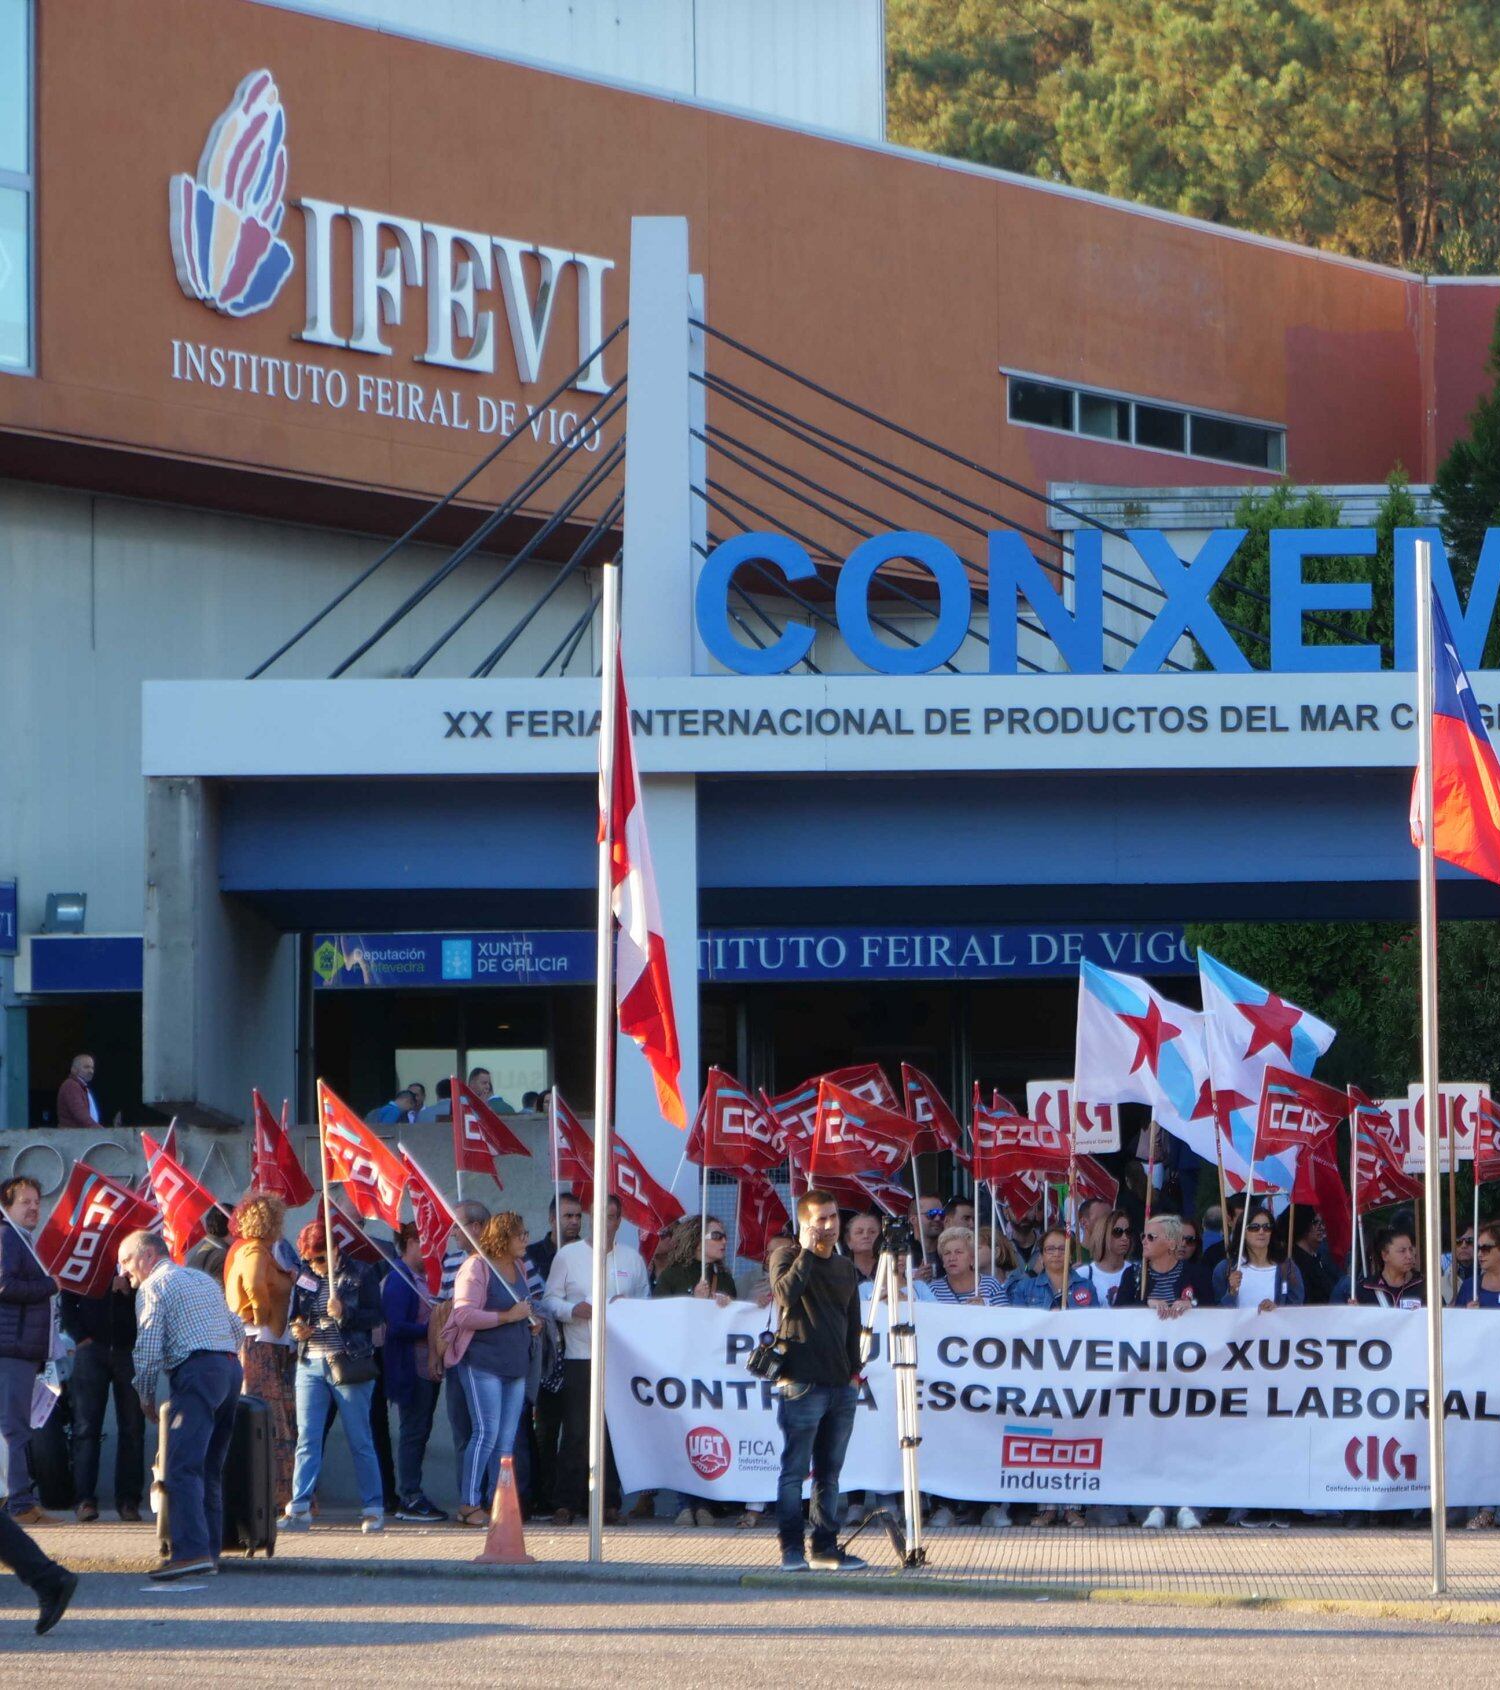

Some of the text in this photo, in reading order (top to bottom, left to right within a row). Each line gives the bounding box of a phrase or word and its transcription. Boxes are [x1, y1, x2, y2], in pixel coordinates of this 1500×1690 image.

[293, 198, 615, 395] IFEVI
[171, 340, 602, 453] INSTITUTO FEIRAL DE VIGO
[443, 710, 493, 738] XX
[506, 709, 602, 738] FERIA
[631, 707, 914, 737] NTERNACIONAL
[924, 707, 971, 736] DE
[984, 705, 1208, 735] PRODUCTOS
[1220, 704, 1289, 733] DEL
[1301, 704, 1379, 732] MAR
[478, 942, 533, 956] XUNTA
[478, 957, 568, 972] DE GALICIA
[697, 935, 847, 969] TITUTO
[860, 934, 1016, 967] FEIRAL
[1029, 932, 1083, 965] DE
[978, 1121, 1062, 1149] CCOO
[59, 1185, 127, 1282] CCOO
[937, 1336, 1393, 1372] CONVENIO XUSTO
[915, 1379, 1249, 1420] SCRAVITUDE
[1266, 1386, 1500, 1422] LABORAL
[688, 1435, 724, 1458] UGT
[738, 1440, 775, 1456] FICA
[1009, 1442, 1095, 1464] CCOO
[1344, 1435, 1417, 1482] CIG
[1000, 1470, 1100, 1491] industria
